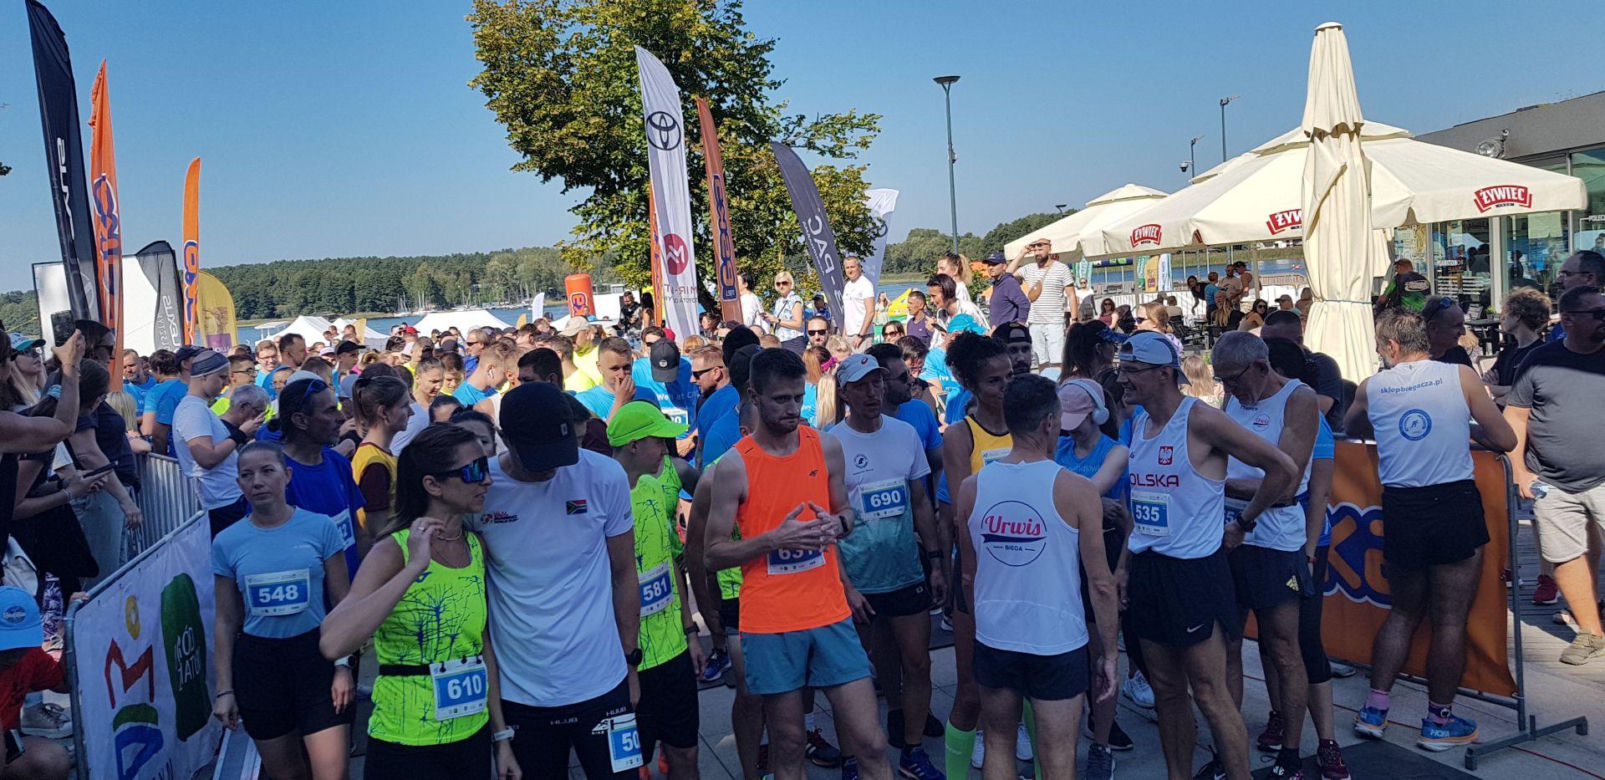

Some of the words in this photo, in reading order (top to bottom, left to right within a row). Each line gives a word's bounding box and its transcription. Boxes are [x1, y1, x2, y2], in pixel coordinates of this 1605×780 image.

[1480, 187, 1525, 204] ŻYWIEC
[1274, 210, 1302, 226] ŻYW
[1130, 473, 1180, 488] OLSKA
[870, 490, 901, 508] 690
[1135, 504, 1160, 522] 535
[985, 515, 1041, 537] Urwis
[258, 584, 299, 604] 548
[642, 576, 668, 601] 581
[447, 674, 483, 700] 610
